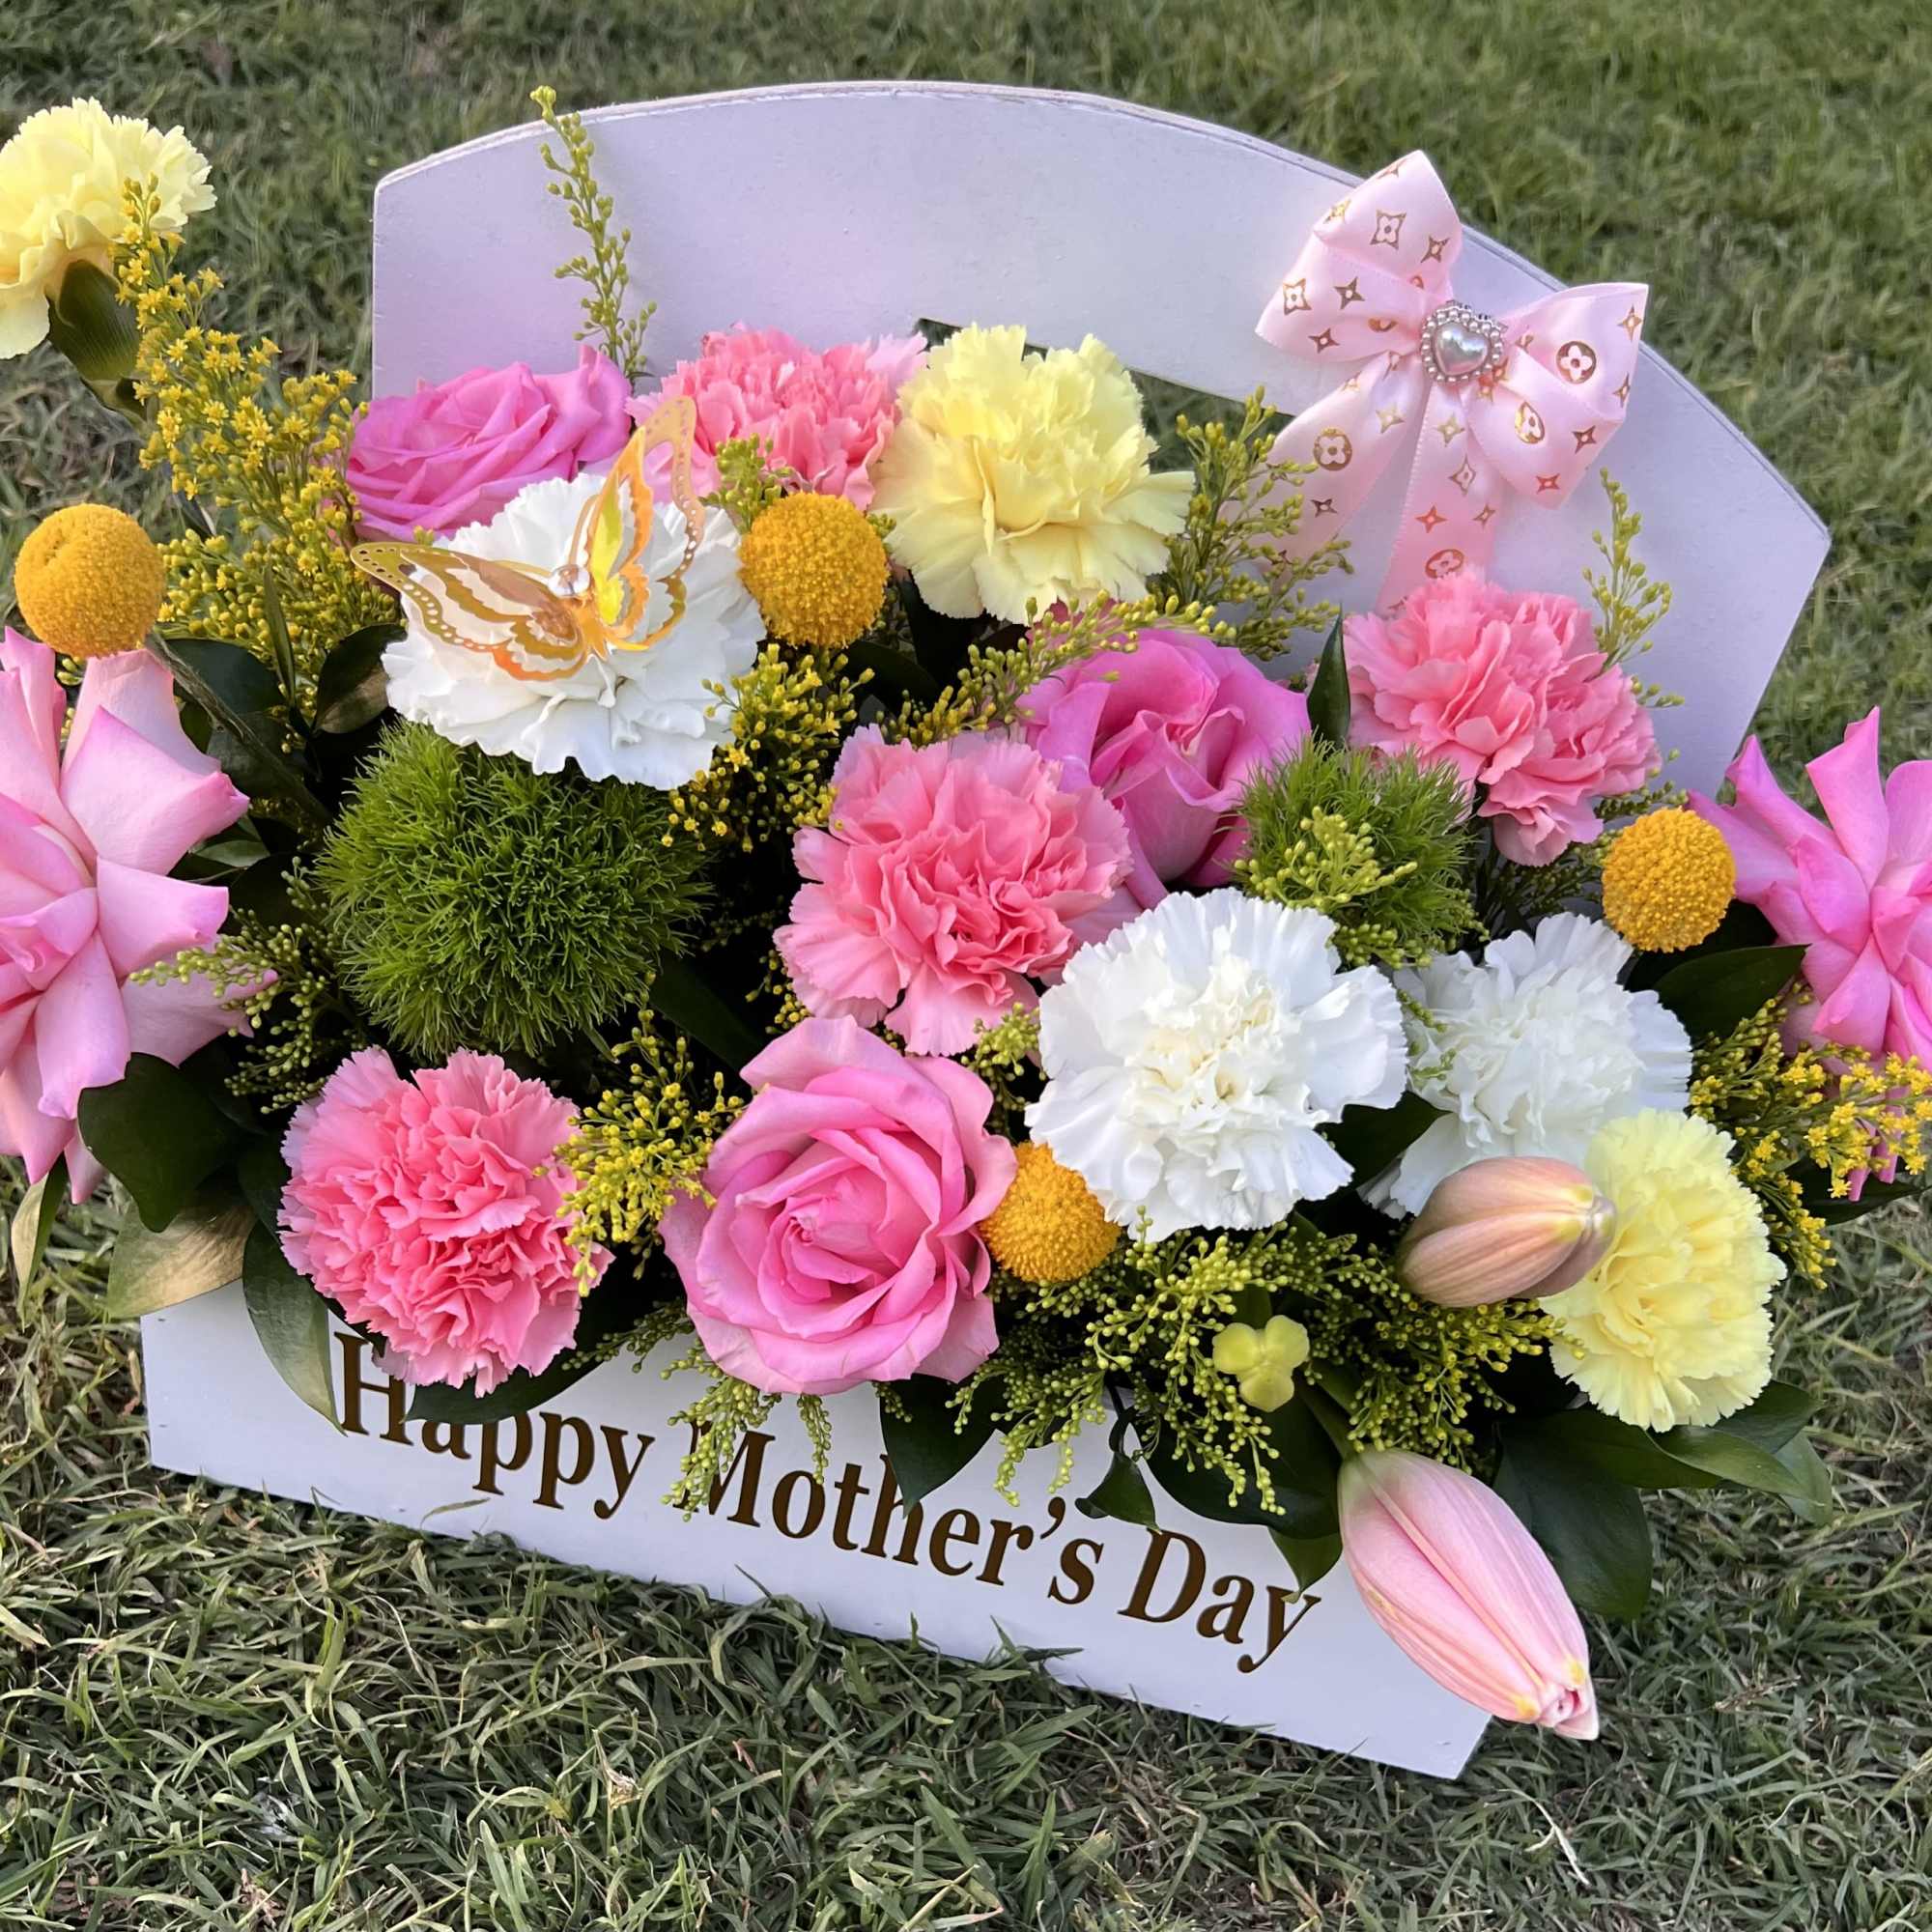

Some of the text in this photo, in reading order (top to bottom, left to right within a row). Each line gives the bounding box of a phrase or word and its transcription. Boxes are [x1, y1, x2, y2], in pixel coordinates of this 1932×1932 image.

[334, 1331, 1321, 1673] Happy Mother's Day
